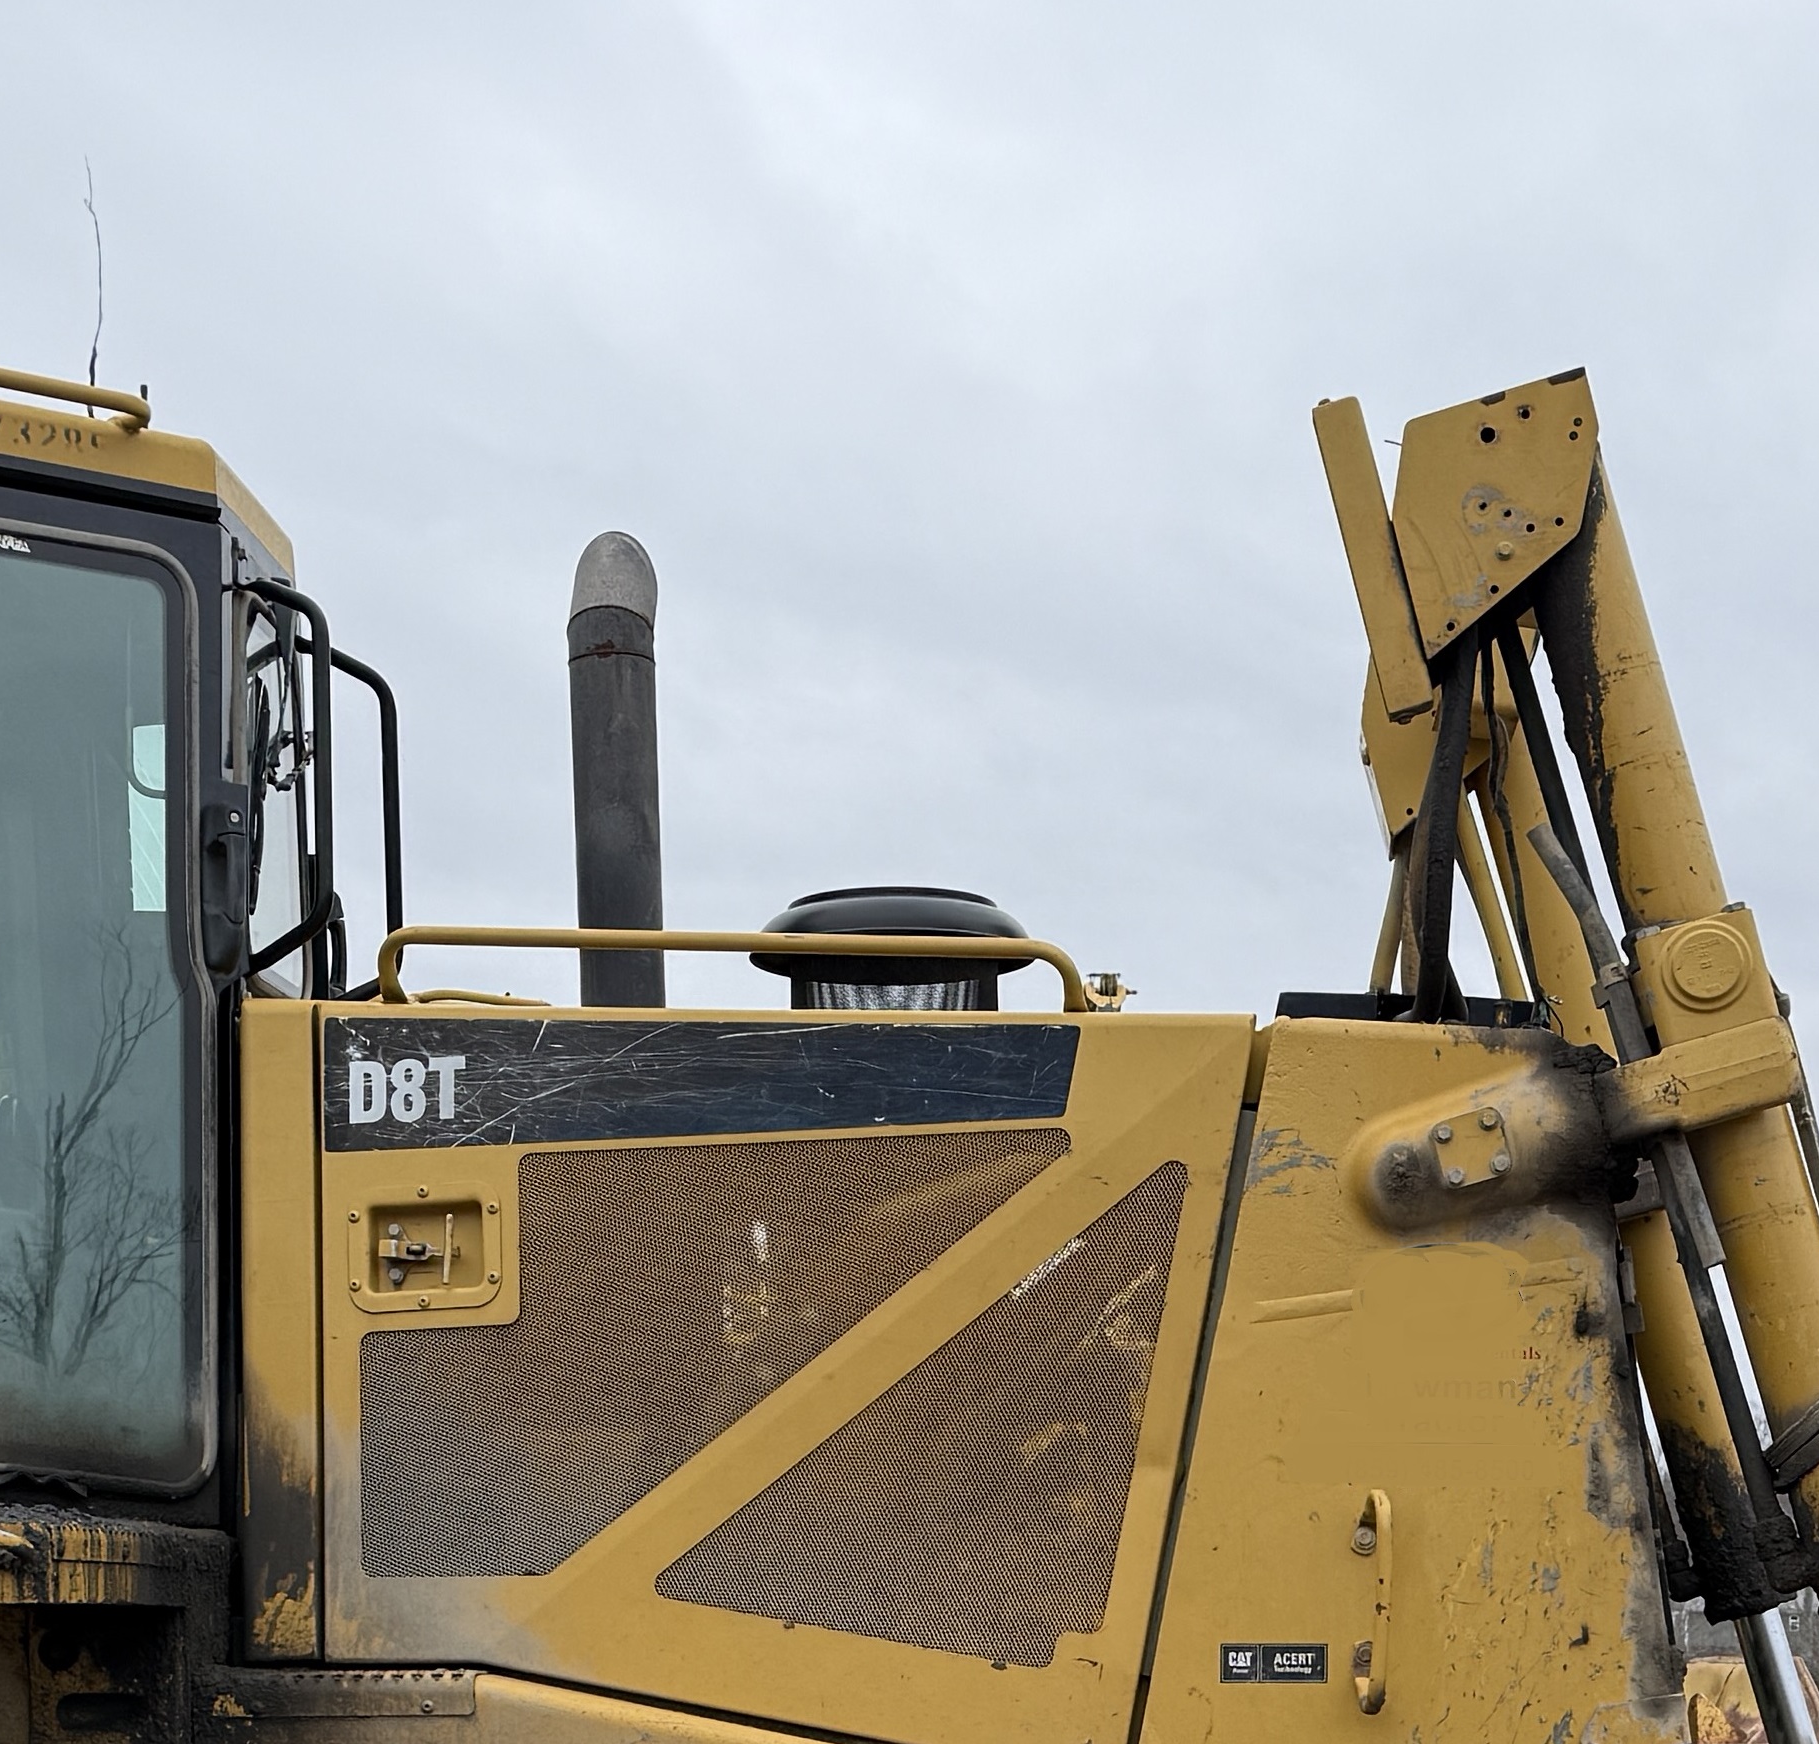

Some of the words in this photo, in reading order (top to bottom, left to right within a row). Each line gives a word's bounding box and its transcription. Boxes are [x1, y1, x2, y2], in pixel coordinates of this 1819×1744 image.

[349, 1056, 466, 1124] D8T
[1228, 1651, 1253, 1667] CAT
[1274, 1653, 1314, 1665] ACERT
